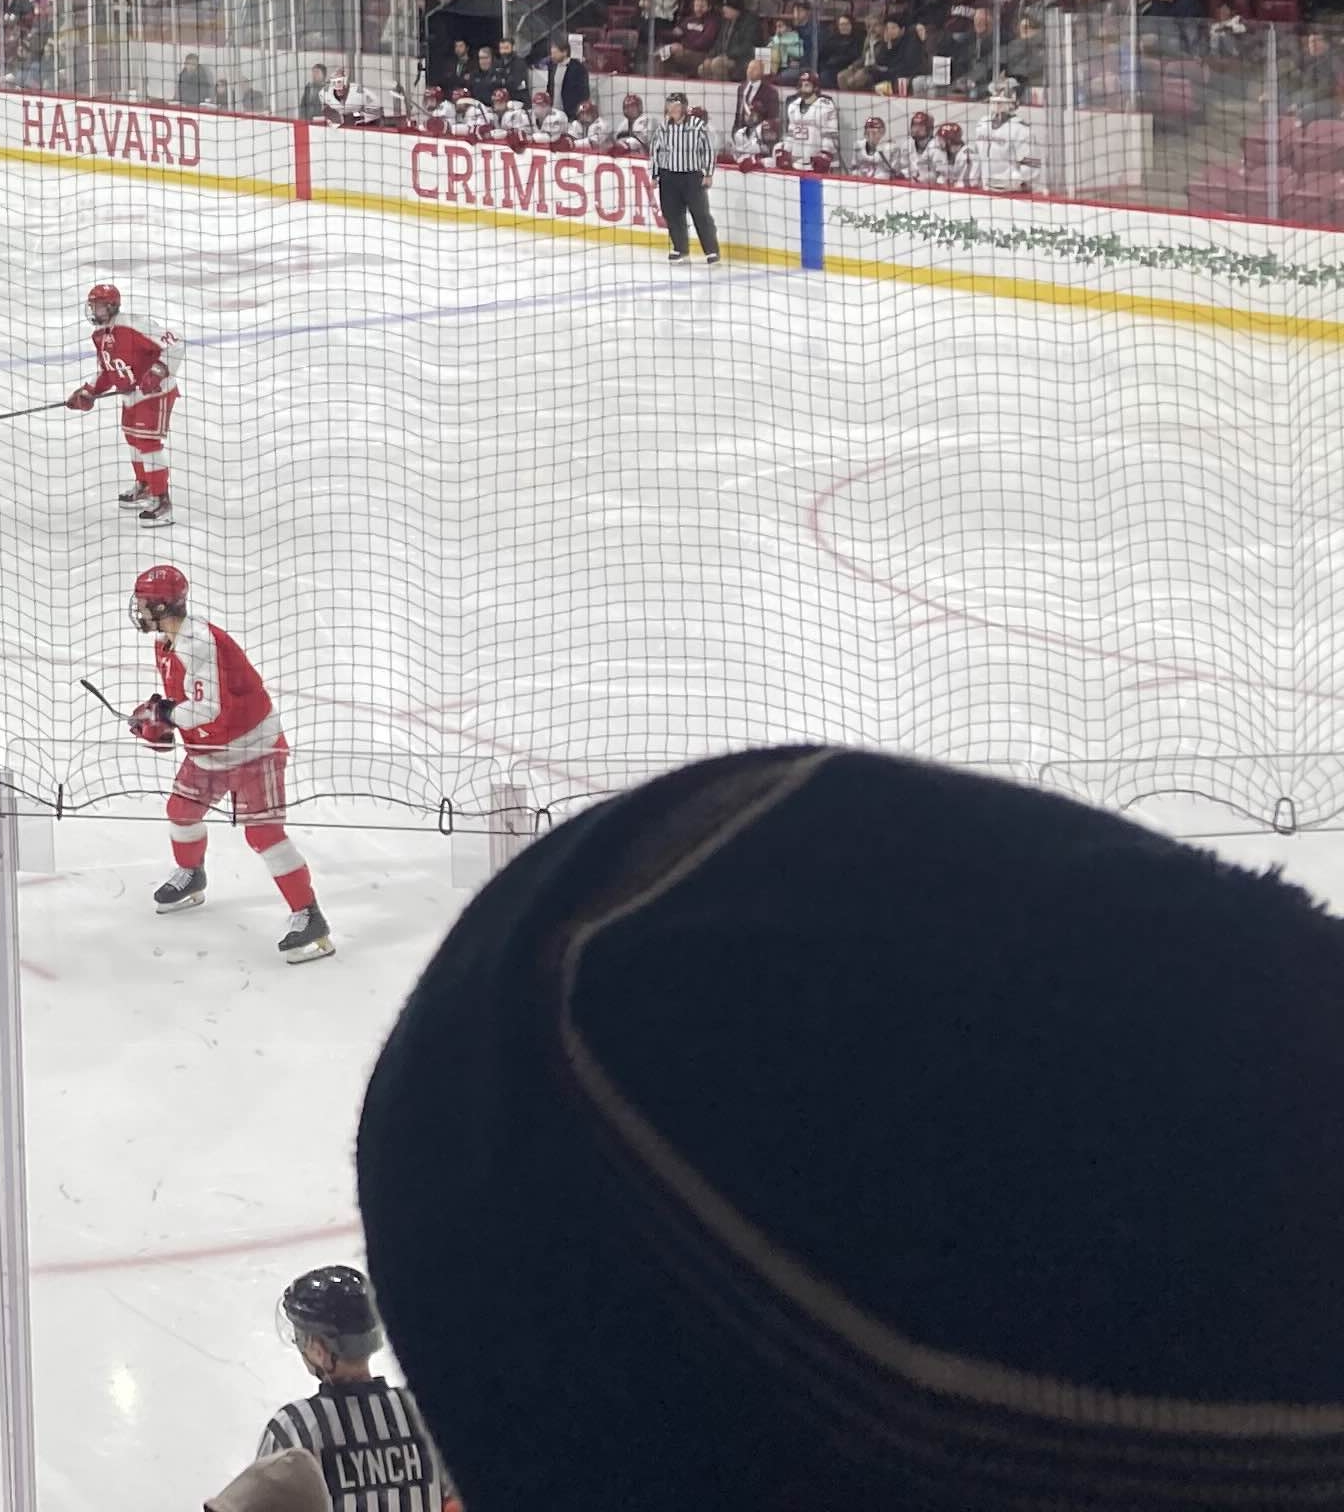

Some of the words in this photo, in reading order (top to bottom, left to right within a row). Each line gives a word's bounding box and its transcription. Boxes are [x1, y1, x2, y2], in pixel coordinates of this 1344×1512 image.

[22, 99, 201, 167] HARVARD
[412, 142, 669, 229] CRIMSON
[193, 680, 204, 702] 6
[335, 1443, 423, 1489] LYNCH
